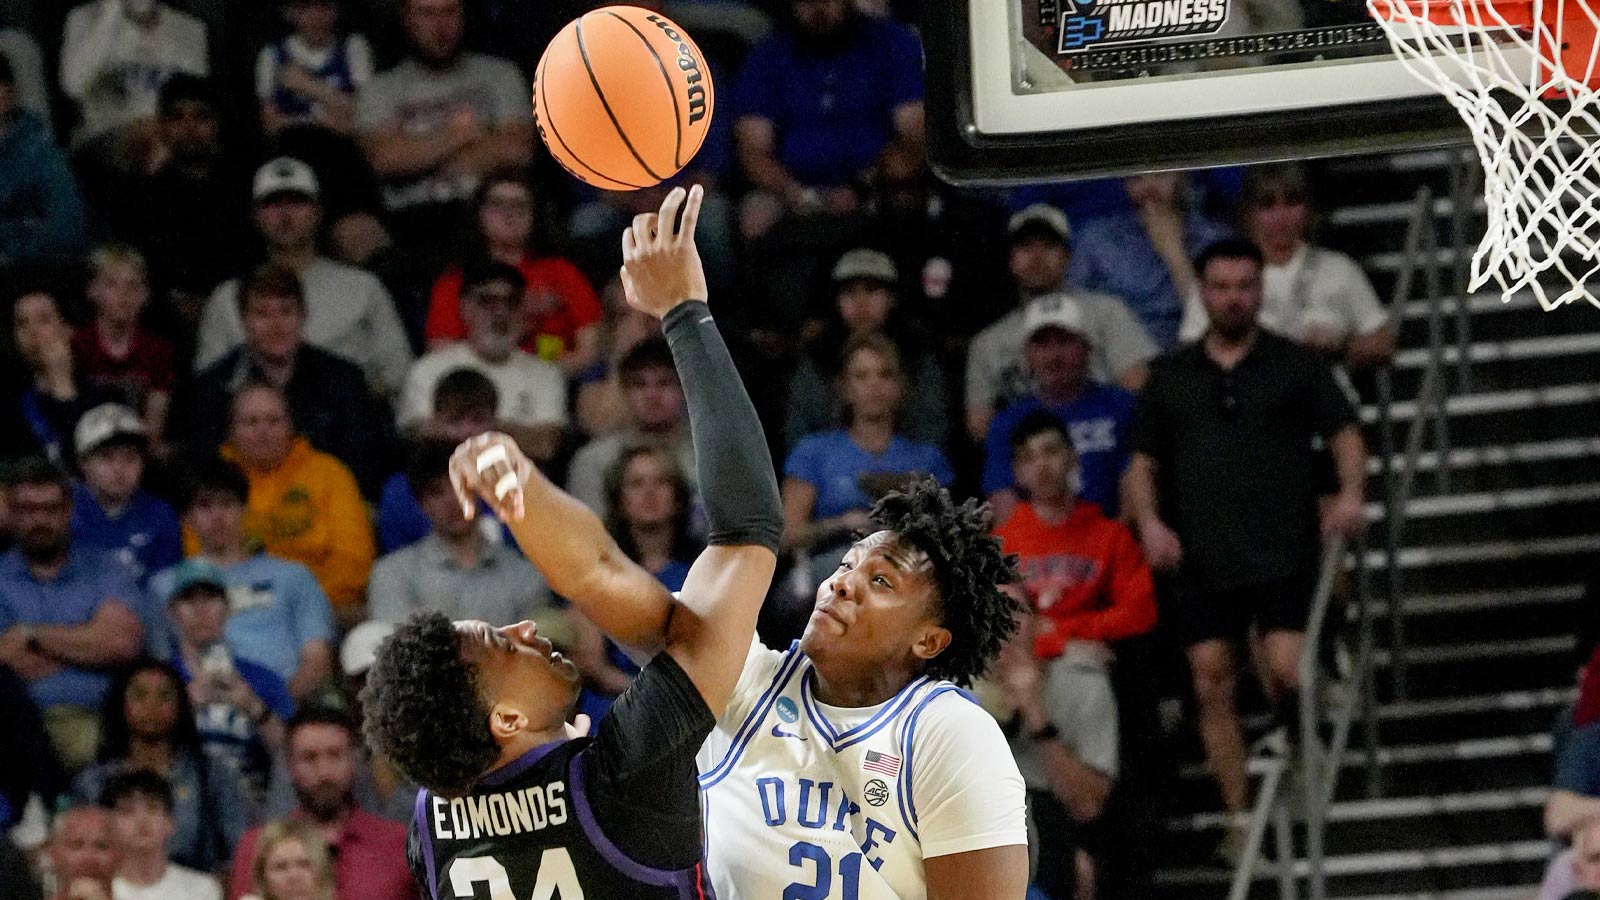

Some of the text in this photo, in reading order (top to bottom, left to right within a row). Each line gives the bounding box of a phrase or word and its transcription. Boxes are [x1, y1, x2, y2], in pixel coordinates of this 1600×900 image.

[1108, 0, 1225, 32] MADNESS
[432, 780, 568, 840] EDMONDS
[783, 841, 863, 900] 21
